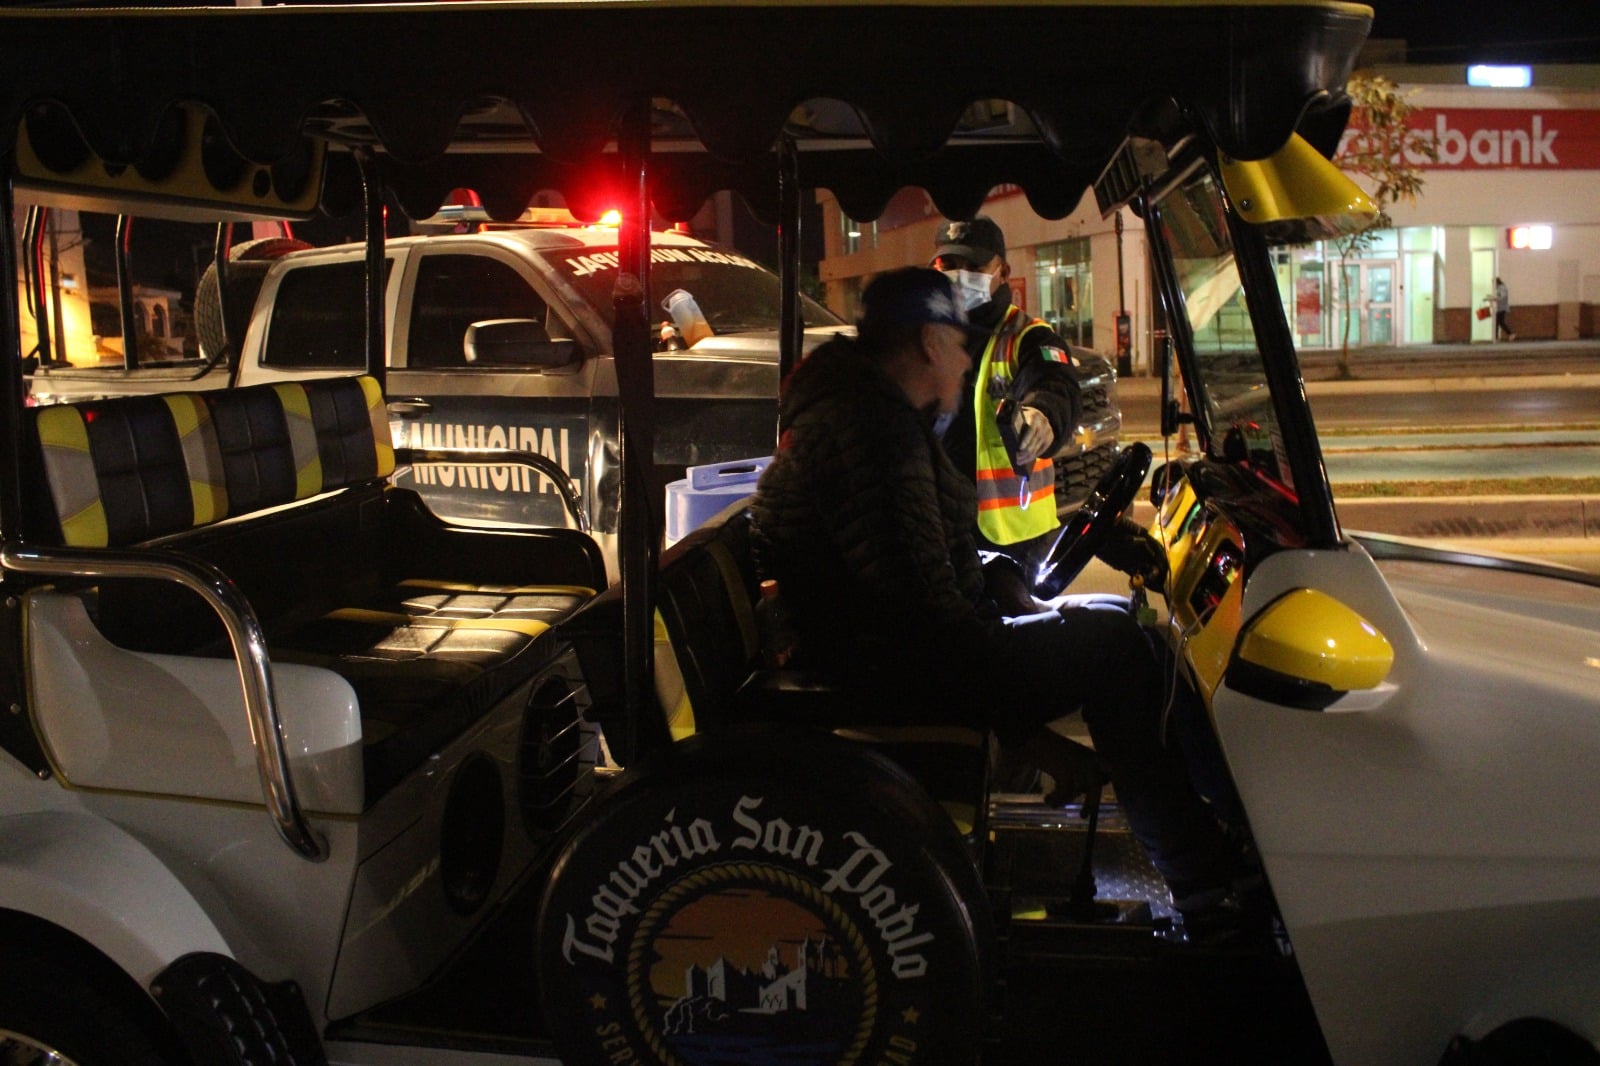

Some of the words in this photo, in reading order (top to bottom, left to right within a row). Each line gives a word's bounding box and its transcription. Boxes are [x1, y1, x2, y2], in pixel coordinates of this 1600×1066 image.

[411, 422, 582, 494] MUNICIPAL
[730, 795, 825, 867] San
[821, 830, 935, 980] Pablo
[595, 1021, 641, 1066] SER
